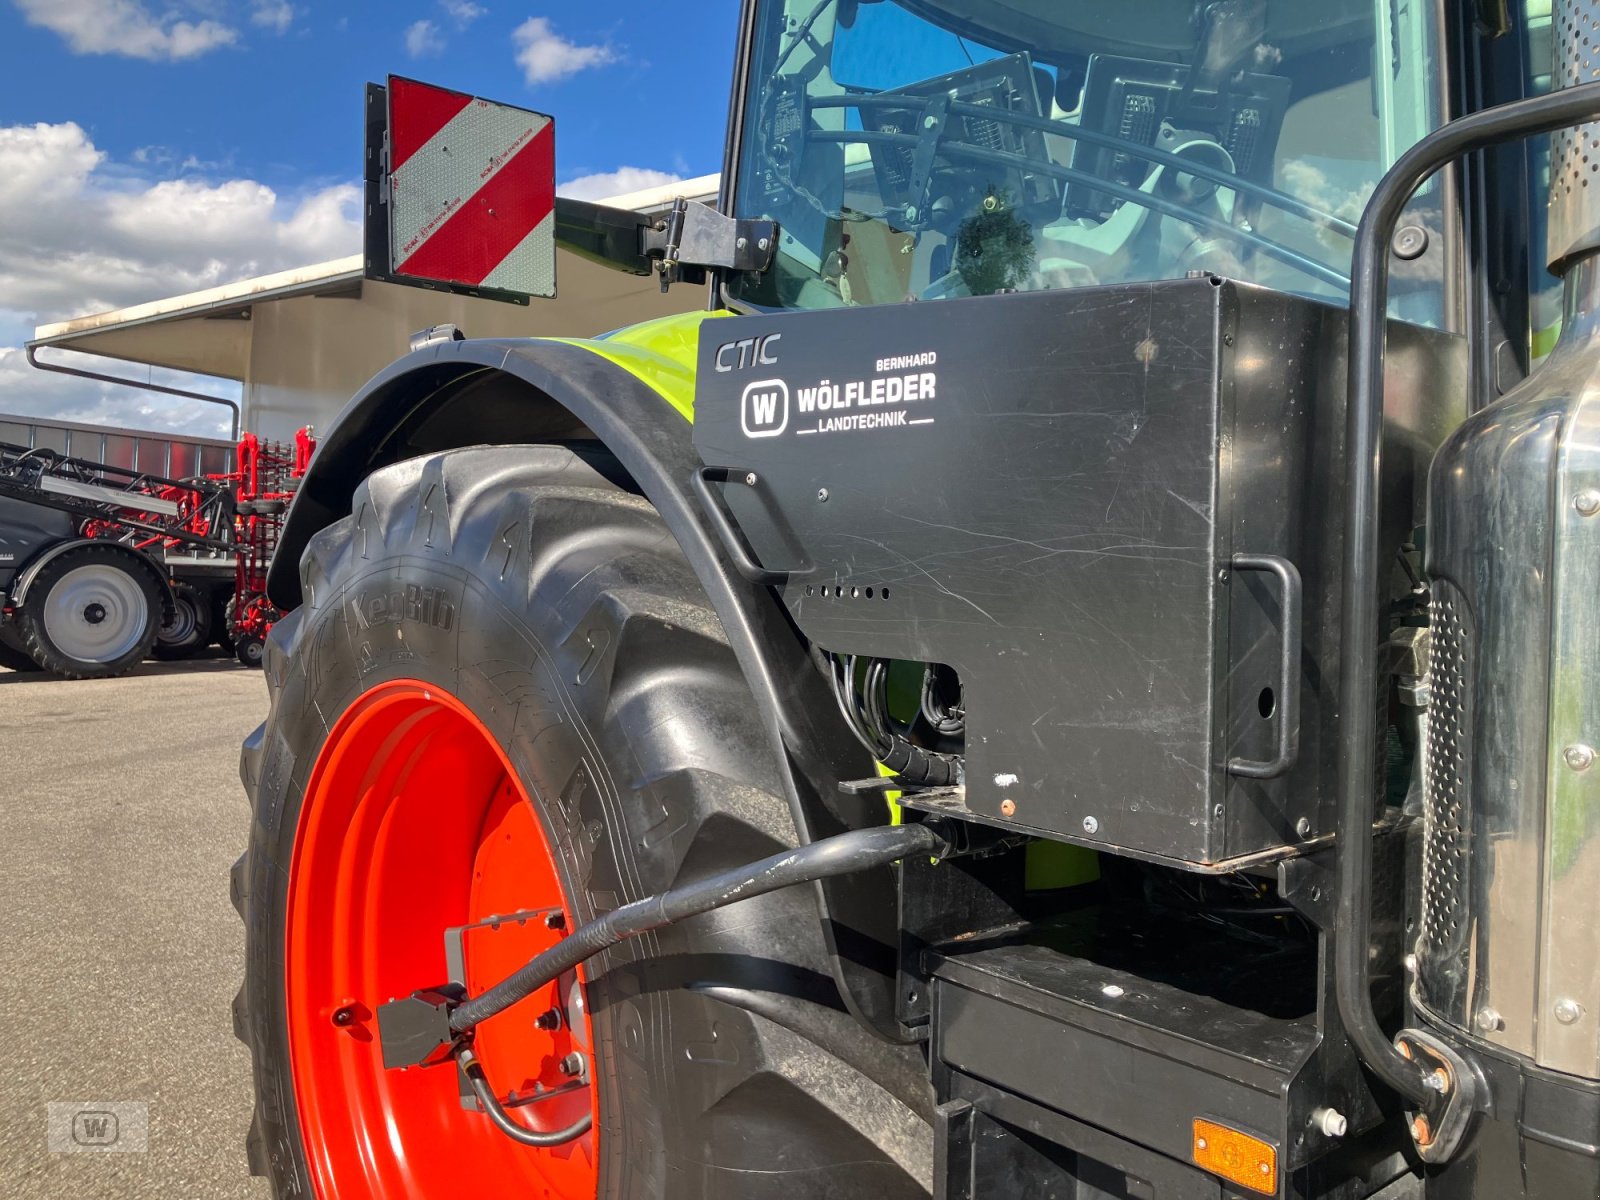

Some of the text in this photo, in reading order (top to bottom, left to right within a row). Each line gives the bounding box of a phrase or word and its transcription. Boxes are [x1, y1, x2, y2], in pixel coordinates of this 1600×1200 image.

[714, 332, 782, 373] CTIC
[876, 351, 937, 372] BERNHARD
[752, 392, 778, 425] W
[797, 372, 936, 413] WÖLFLEDER
[818, 410, 907, 433] LANDTECHNIK
